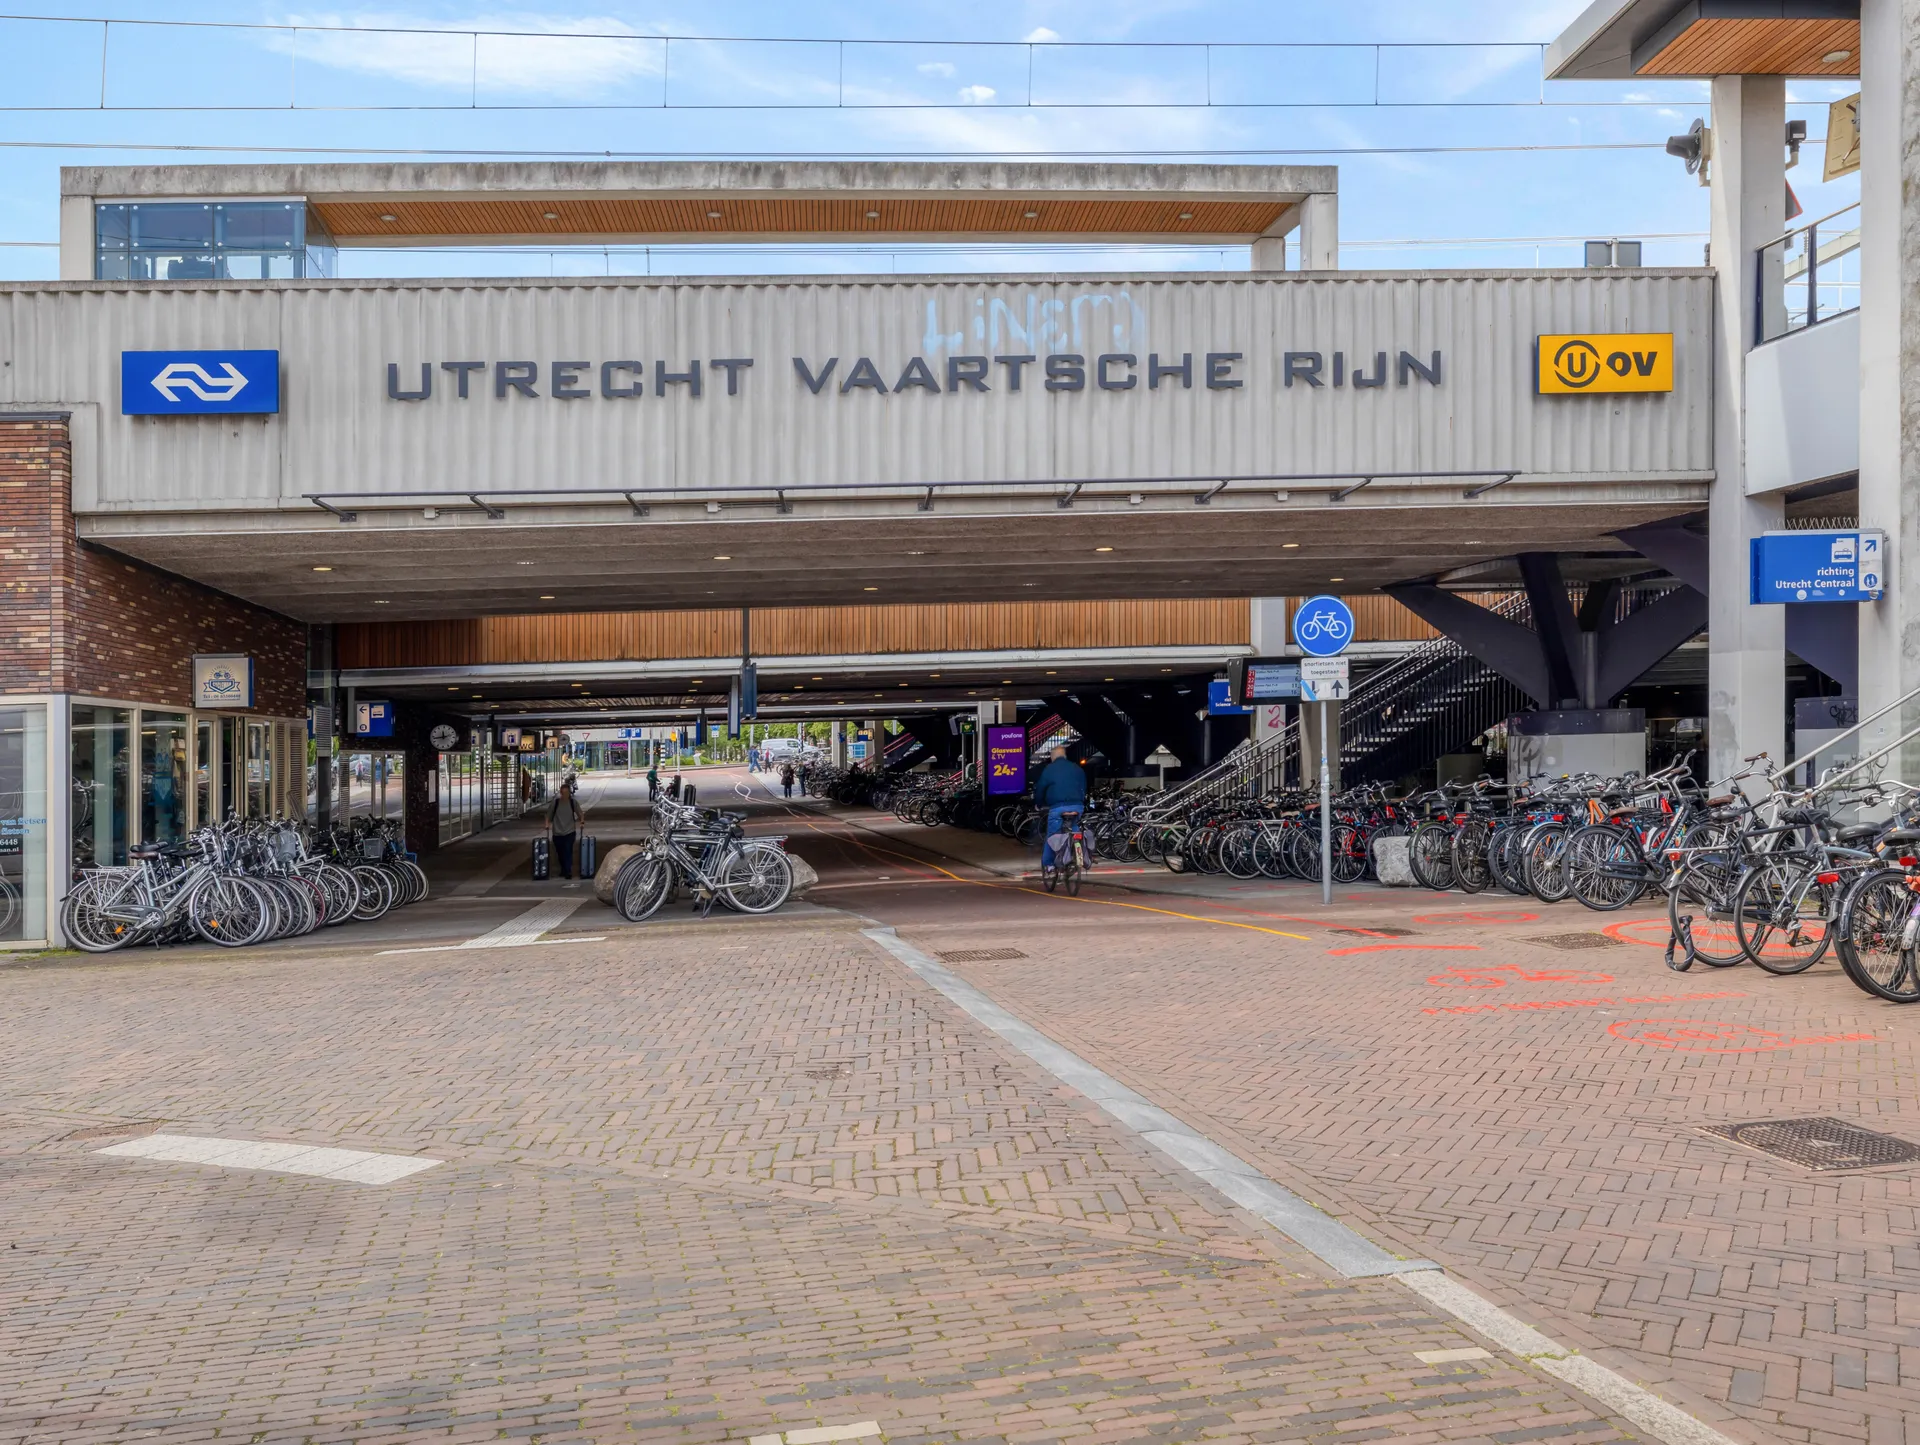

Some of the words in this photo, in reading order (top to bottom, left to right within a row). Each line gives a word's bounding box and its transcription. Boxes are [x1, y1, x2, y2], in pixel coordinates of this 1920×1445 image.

[1606, 351, 1658, 377] OV
[387, 358, 754, 400] UTRECHT
[793, 352, 1243, 395] VAARTSCHE
[1284, 350, 1442, 388] RIJN
[1817, 567, 1855, 577] richting
[1775, 580, 1811, 588] Utrecht
[1814, 579, 1855, 588] Centraal
